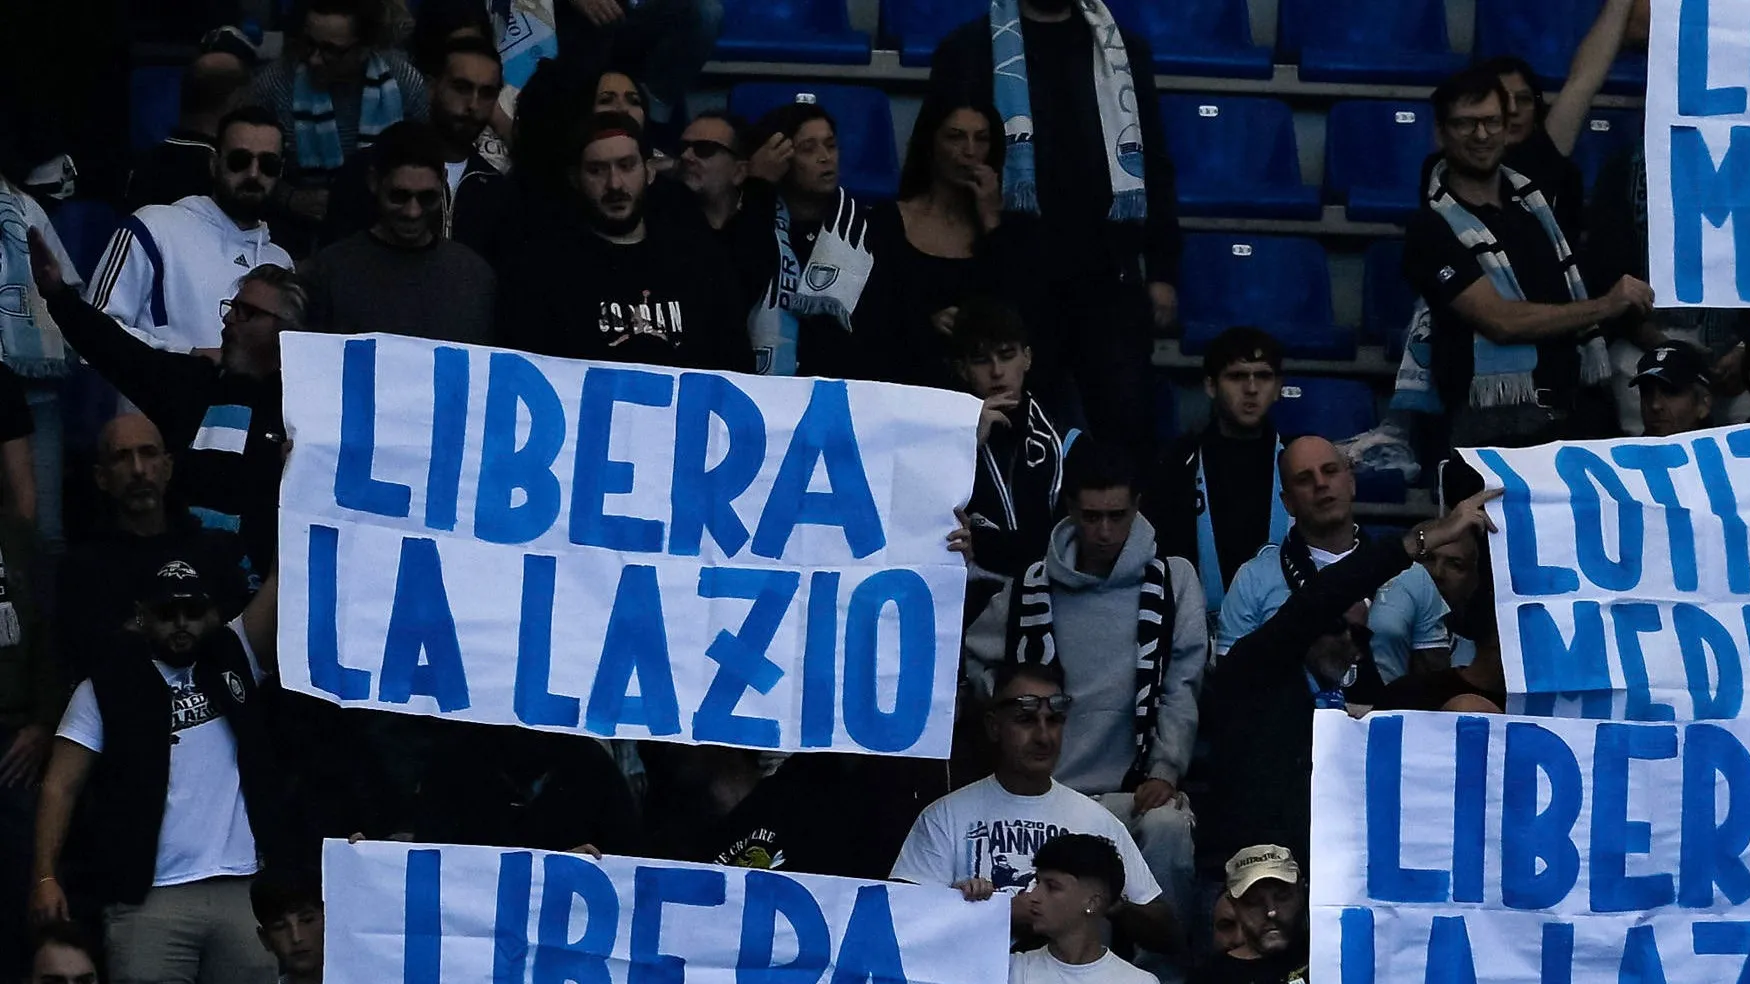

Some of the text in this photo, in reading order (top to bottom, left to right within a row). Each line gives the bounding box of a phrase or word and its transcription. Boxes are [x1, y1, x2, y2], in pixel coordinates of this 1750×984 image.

[334, 339, 887, 560] LIBERA
[307, 526, 471, 713] LA
[512, 554, 938, 753] LAZIO
